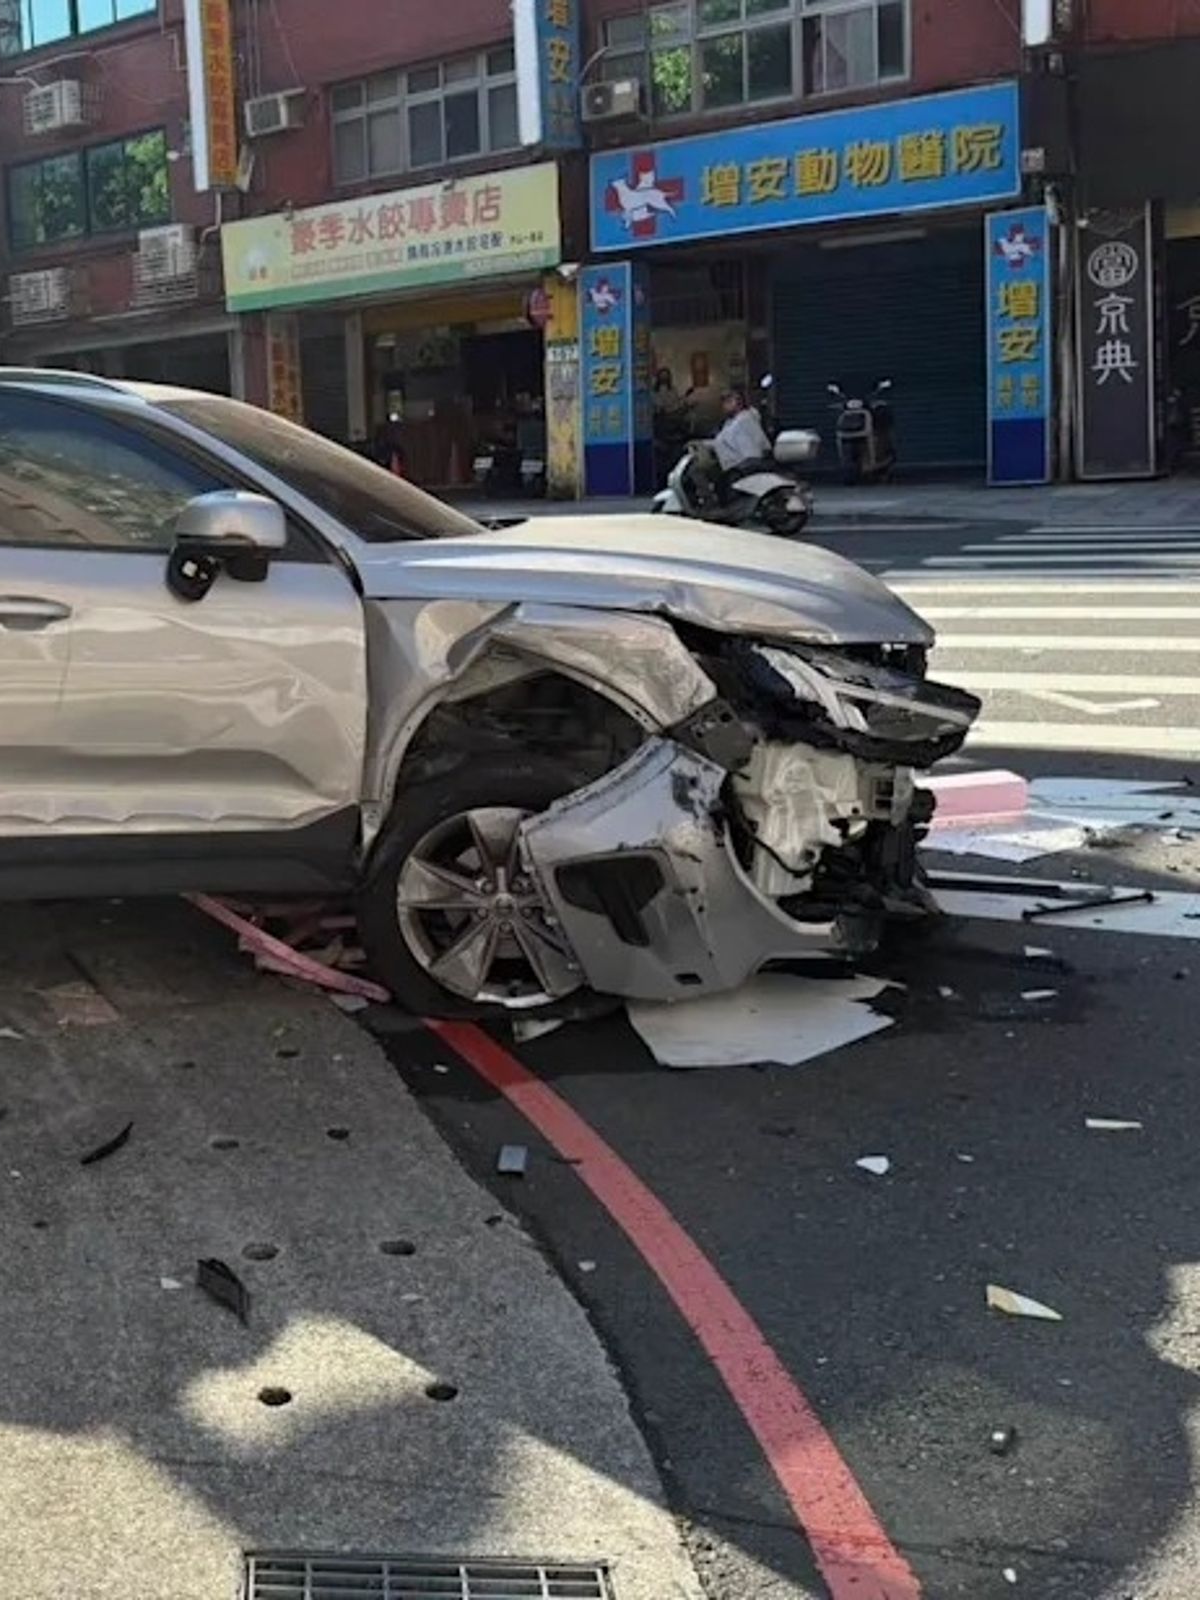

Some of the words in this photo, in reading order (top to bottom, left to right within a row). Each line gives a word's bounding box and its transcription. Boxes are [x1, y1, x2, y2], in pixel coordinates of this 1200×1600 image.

[701, 122, 1007, 207] 增安動物醫院
[290, 185, 501, 255] 豪季水餃專賣店
[592, 326, 622, 396] 增安
[1000, 280, 1040, 363] 增安
[1092, 293, 1138, 385] 京典
